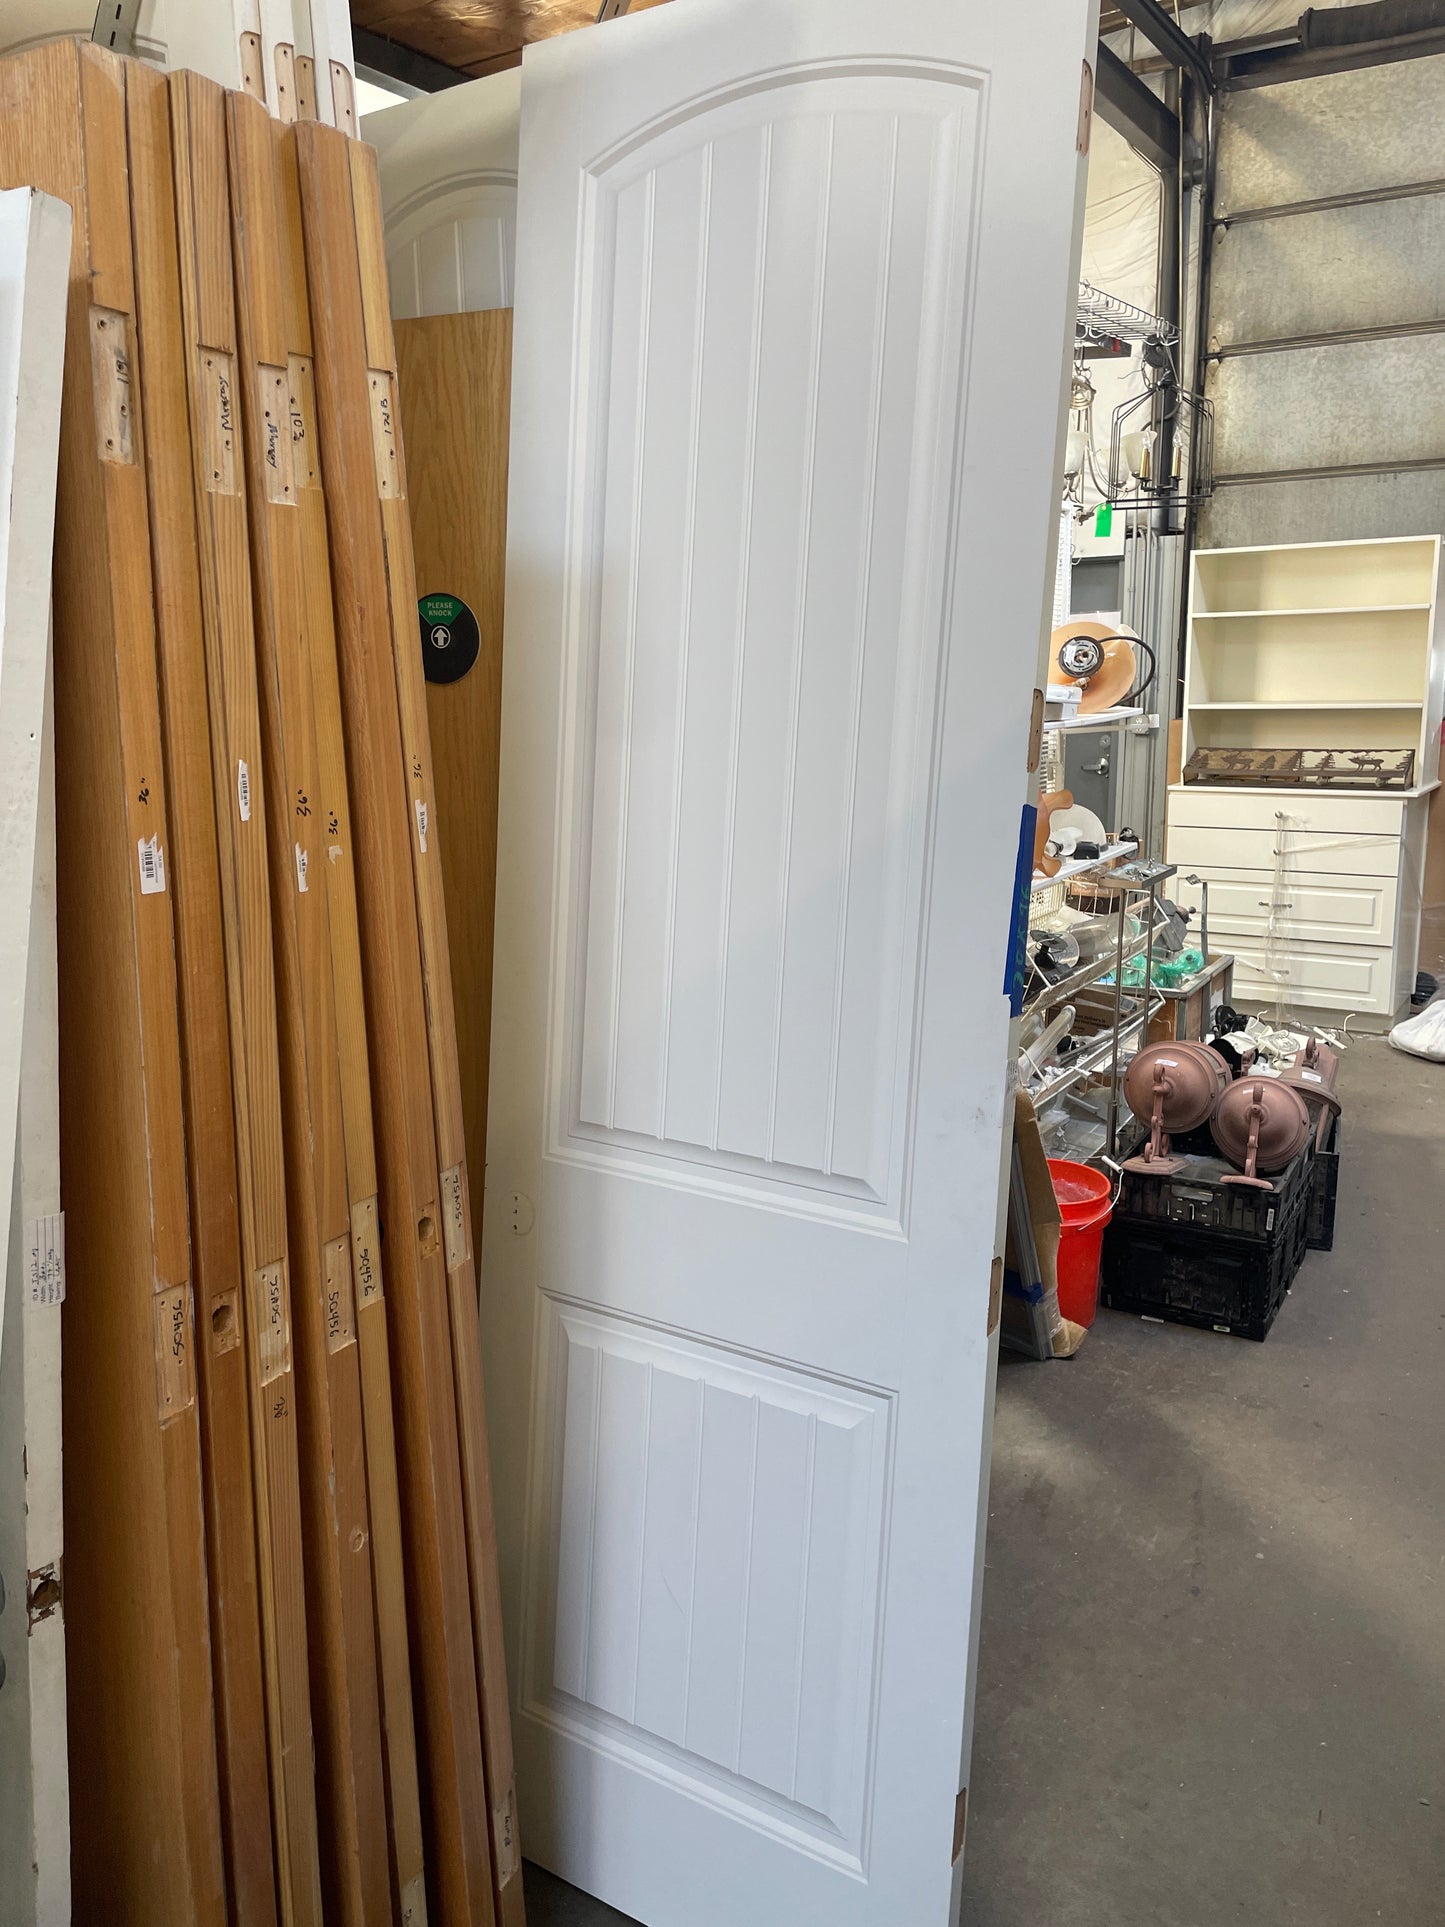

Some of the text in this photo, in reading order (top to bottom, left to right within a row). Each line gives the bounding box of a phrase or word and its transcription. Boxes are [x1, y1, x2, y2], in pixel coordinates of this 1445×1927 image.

[290, 412, 305, 441] 103
[427, 601, 453, 609] PLEASE
[428, 609, 453, 617] KNOCK
[360, 1248, 373, 1297] 50456
[172, 1299, 185, 1357] 50456
